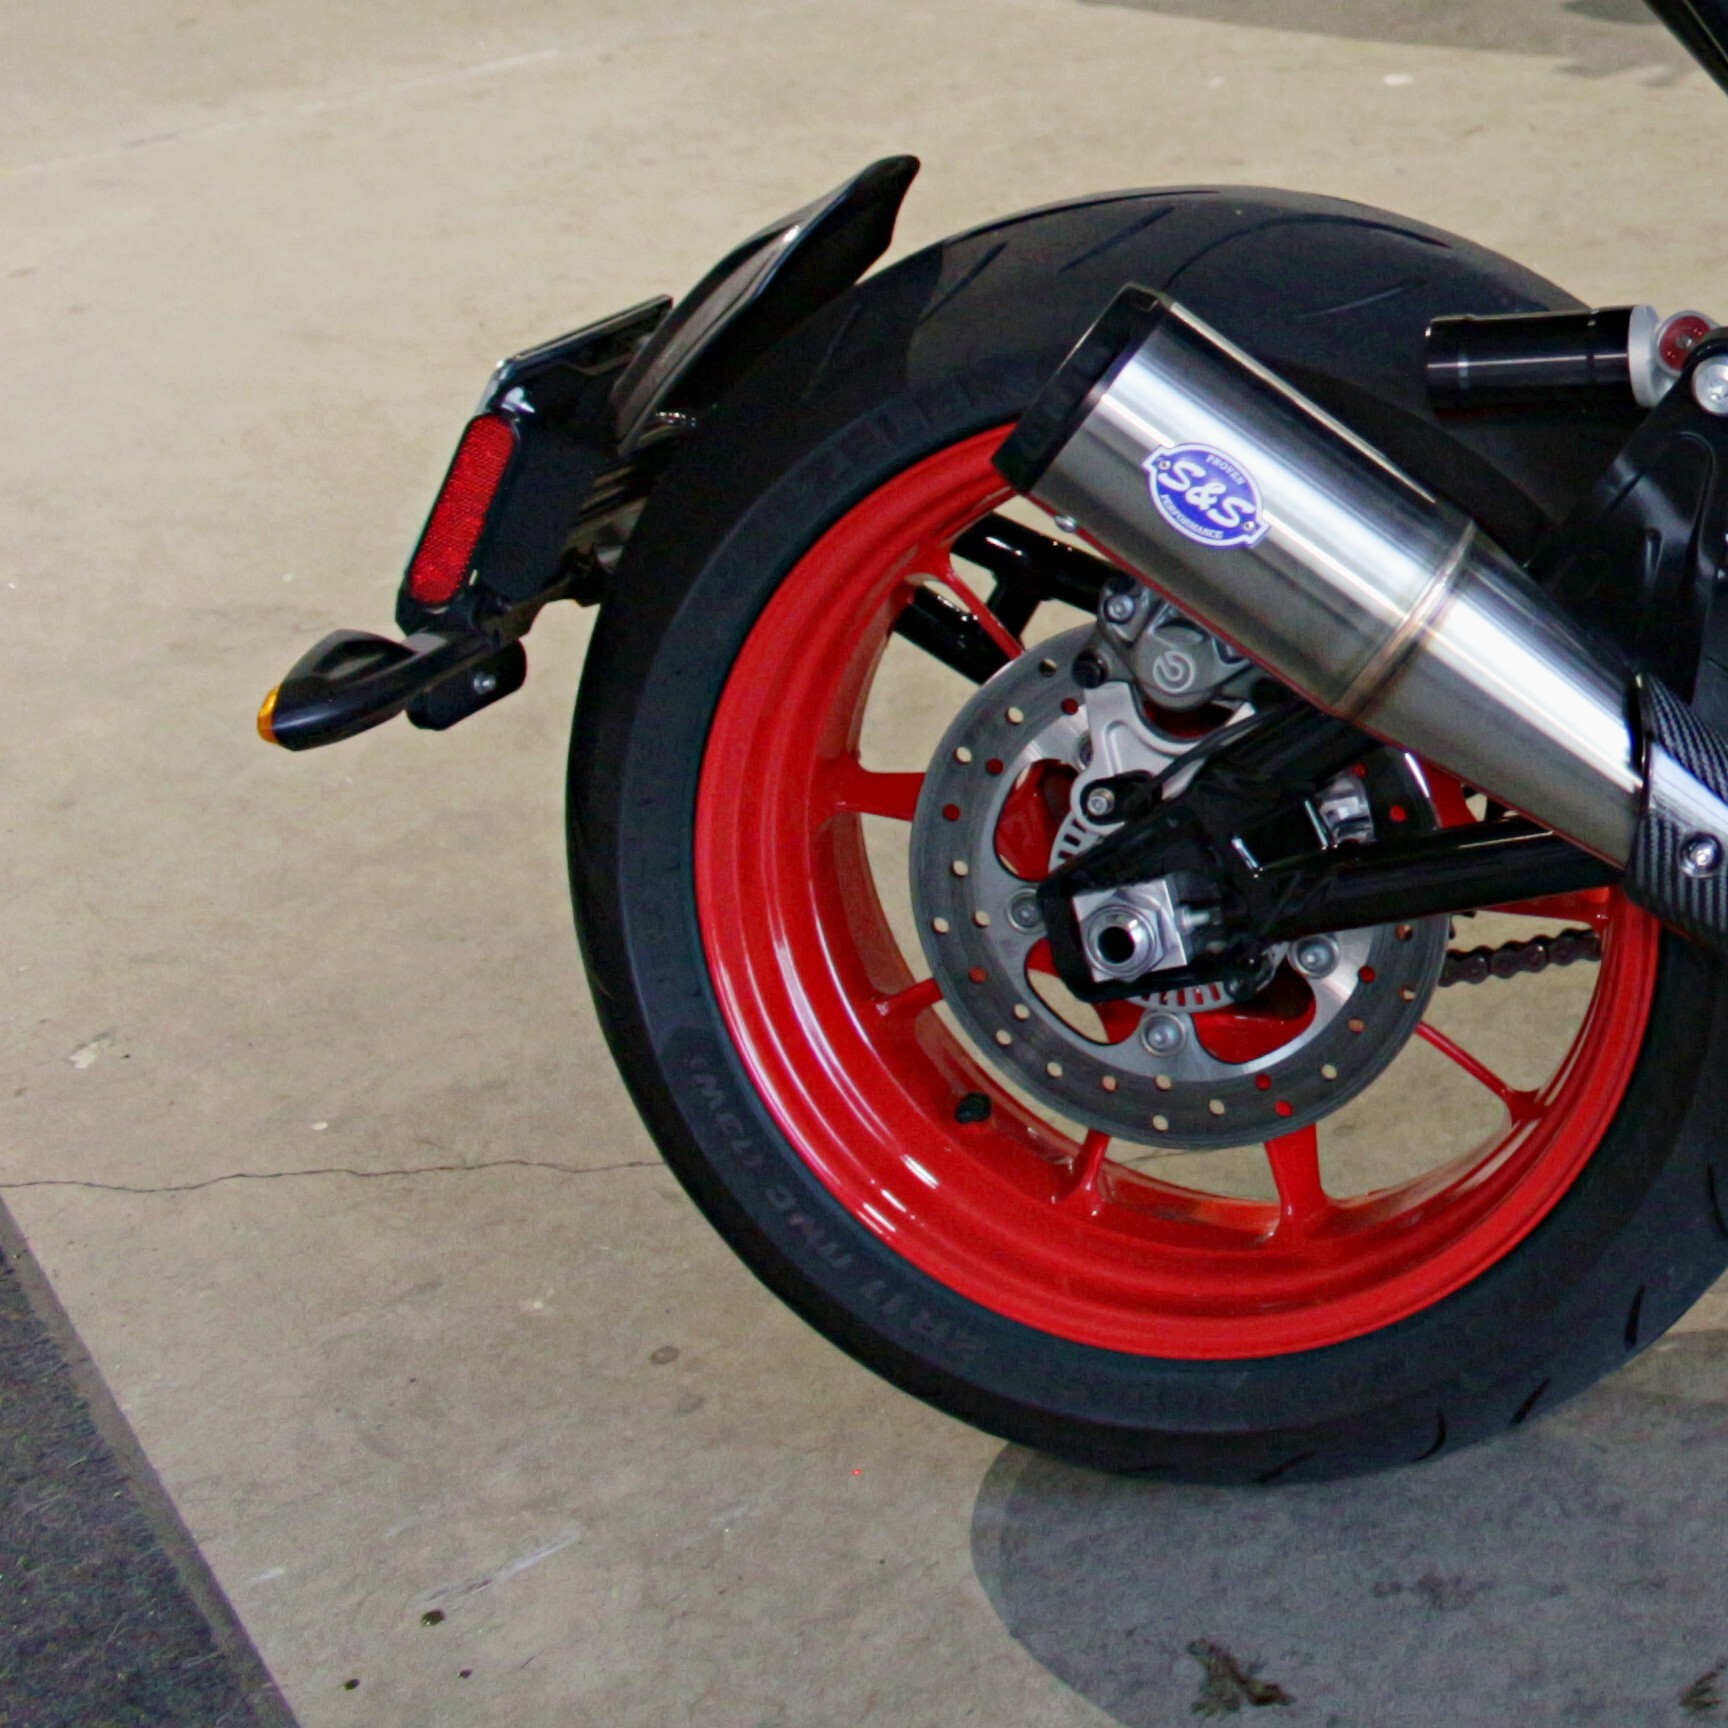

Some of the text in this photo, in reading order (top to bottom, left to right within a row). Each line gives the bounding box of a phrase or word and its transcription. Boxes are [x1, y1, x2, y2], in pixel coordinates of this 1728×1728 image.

[1205, 454, 1246, 485] PROVEN
[1158, 459, 1256, 529] S&S
[1160, 493, 1225, 540] PERFORMANCE
